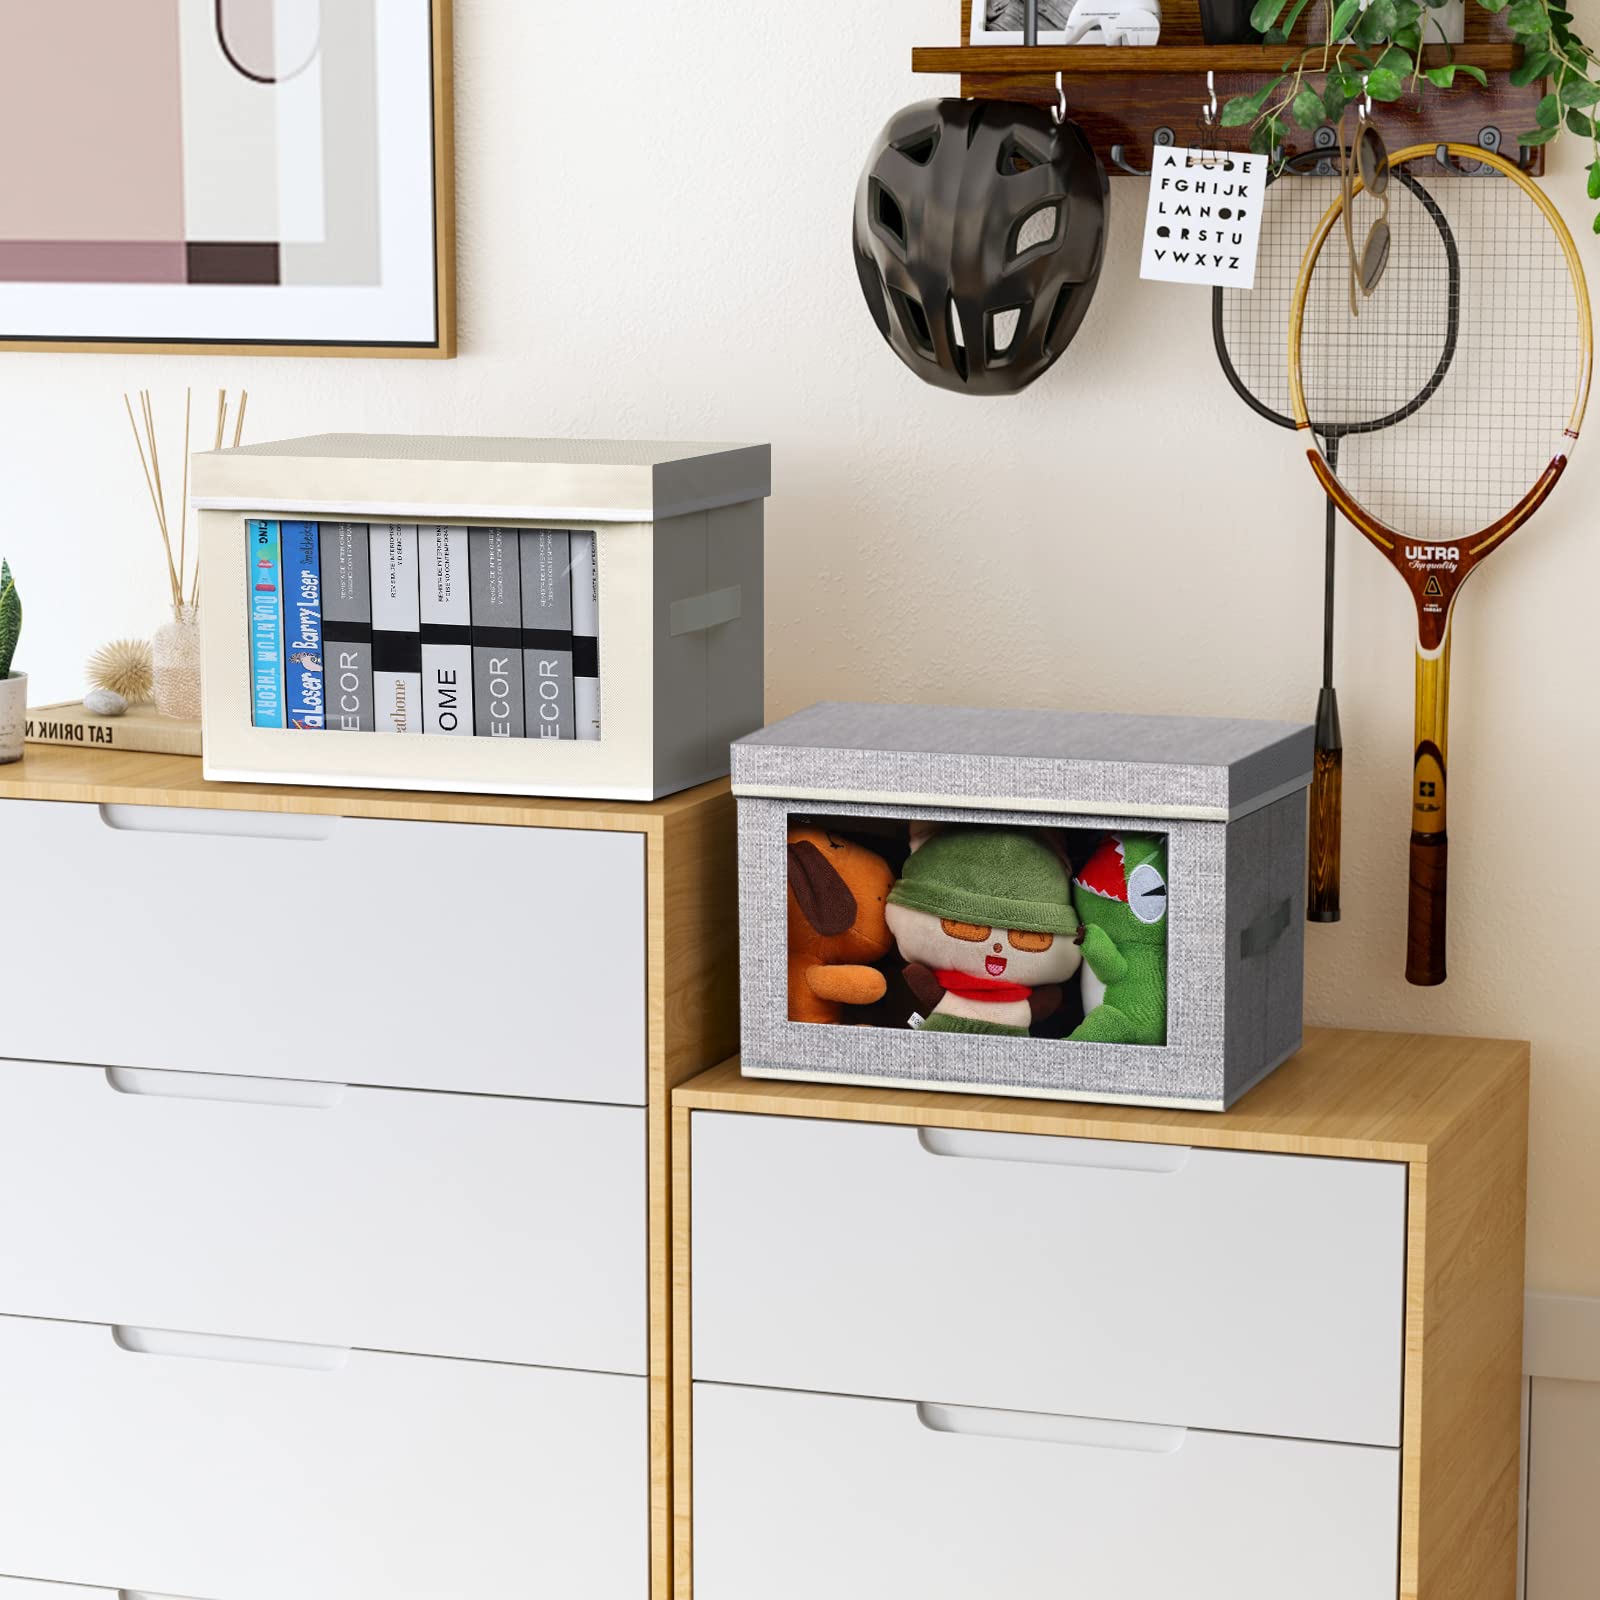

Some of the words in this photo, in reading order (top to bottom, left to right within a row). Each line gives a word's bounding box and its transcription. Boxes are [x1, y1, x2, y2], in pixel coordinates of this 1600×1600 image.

[1405, 545, 1459, 561] ULTRA
[297, 570, 319, 607] Loser
[254, 595, 278, 661] QUANTUM
[292, 607, 321, 650] Barry
[256, 668, 278, 717] THEORY
[339, 652, 360, 731] ECOR
[437, 669, 458, 731] OME
[489, 657, 510, 737] ECOR
[539, 660, 560, 739] ECOR
